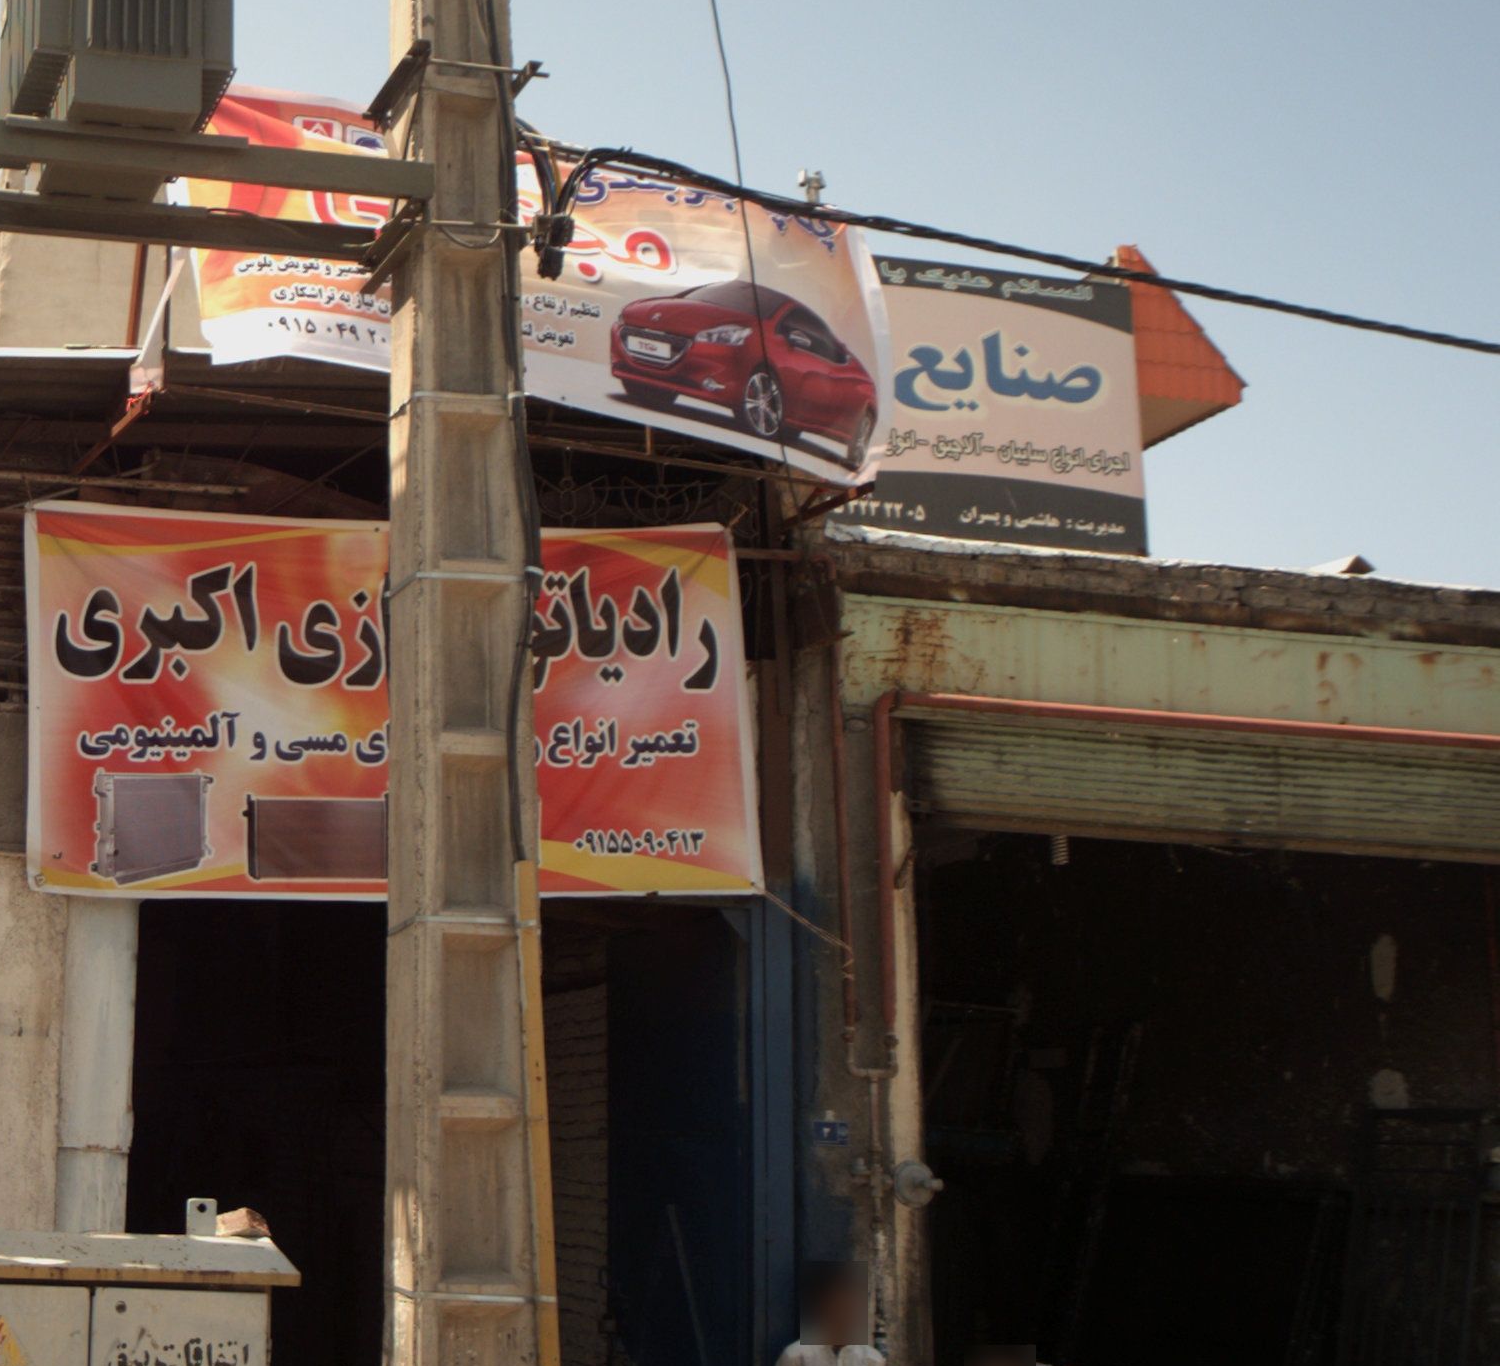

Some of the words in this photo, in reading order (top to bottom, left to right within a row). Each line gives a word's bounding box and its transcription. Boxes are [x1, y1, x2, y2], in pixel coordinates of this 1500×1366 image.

[278, 258, 320, 273] تعویض
[893, 330, 1102, 412] صنایع
[54, 562, 258, 683] اکبری
[78, 710, 241, 761] آلمینیومی
[249, 730, 267, 761] و
[274, 730, 349, 762] مسی
[548, 718, 616, 766] انواع
[623, 720, 699, 766] تعمیر
[574, 829, 705, 855] ۰۹۱۵۵۰۹۰۴۱۳
